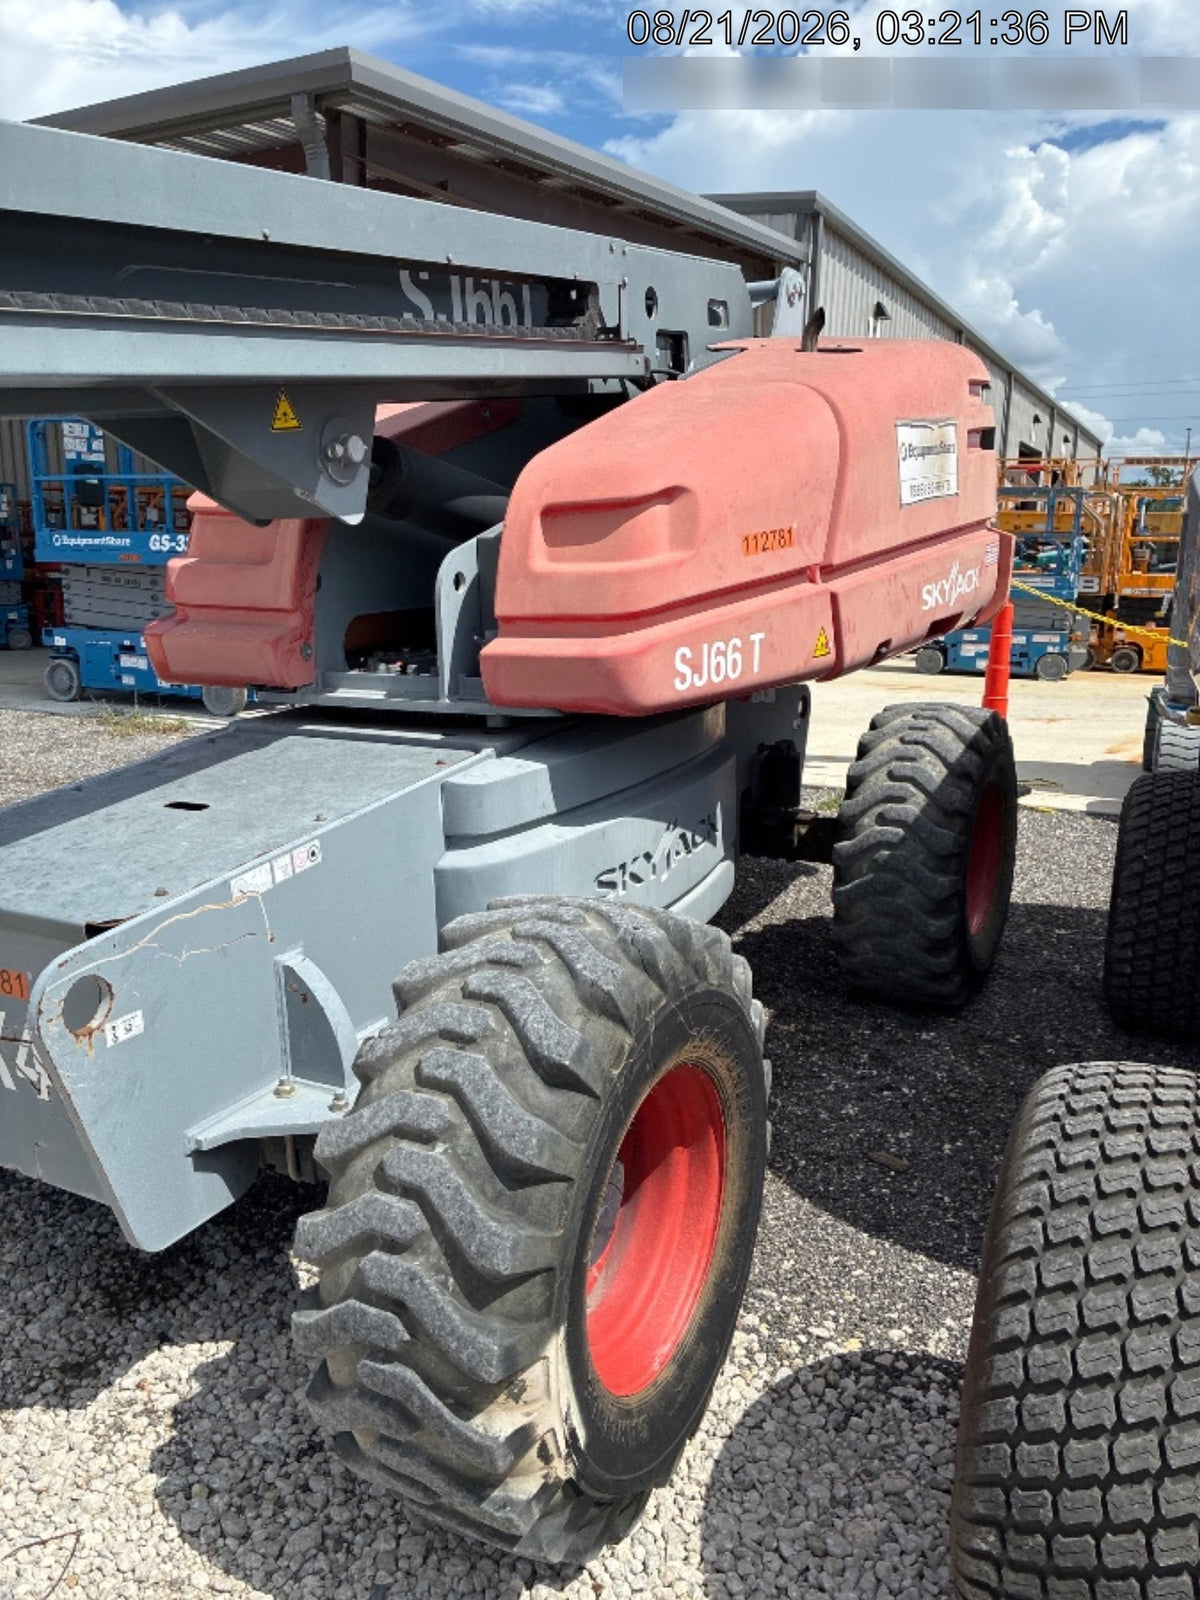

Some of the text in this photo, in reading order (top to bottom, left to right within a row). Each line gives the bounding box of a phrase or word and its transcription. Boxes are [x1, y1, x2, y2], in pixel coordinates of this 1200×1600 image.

[61, 534, 131, 547] EquipmentShare
[149, 533, 190, 552] GS-3
[742, 526, 793, 553] 112781
[921, 559, 980, 611] SKYJACK
[673, 632, 766, 692] SJ66 T
[593, 812, 720, 899] SKYJACK
